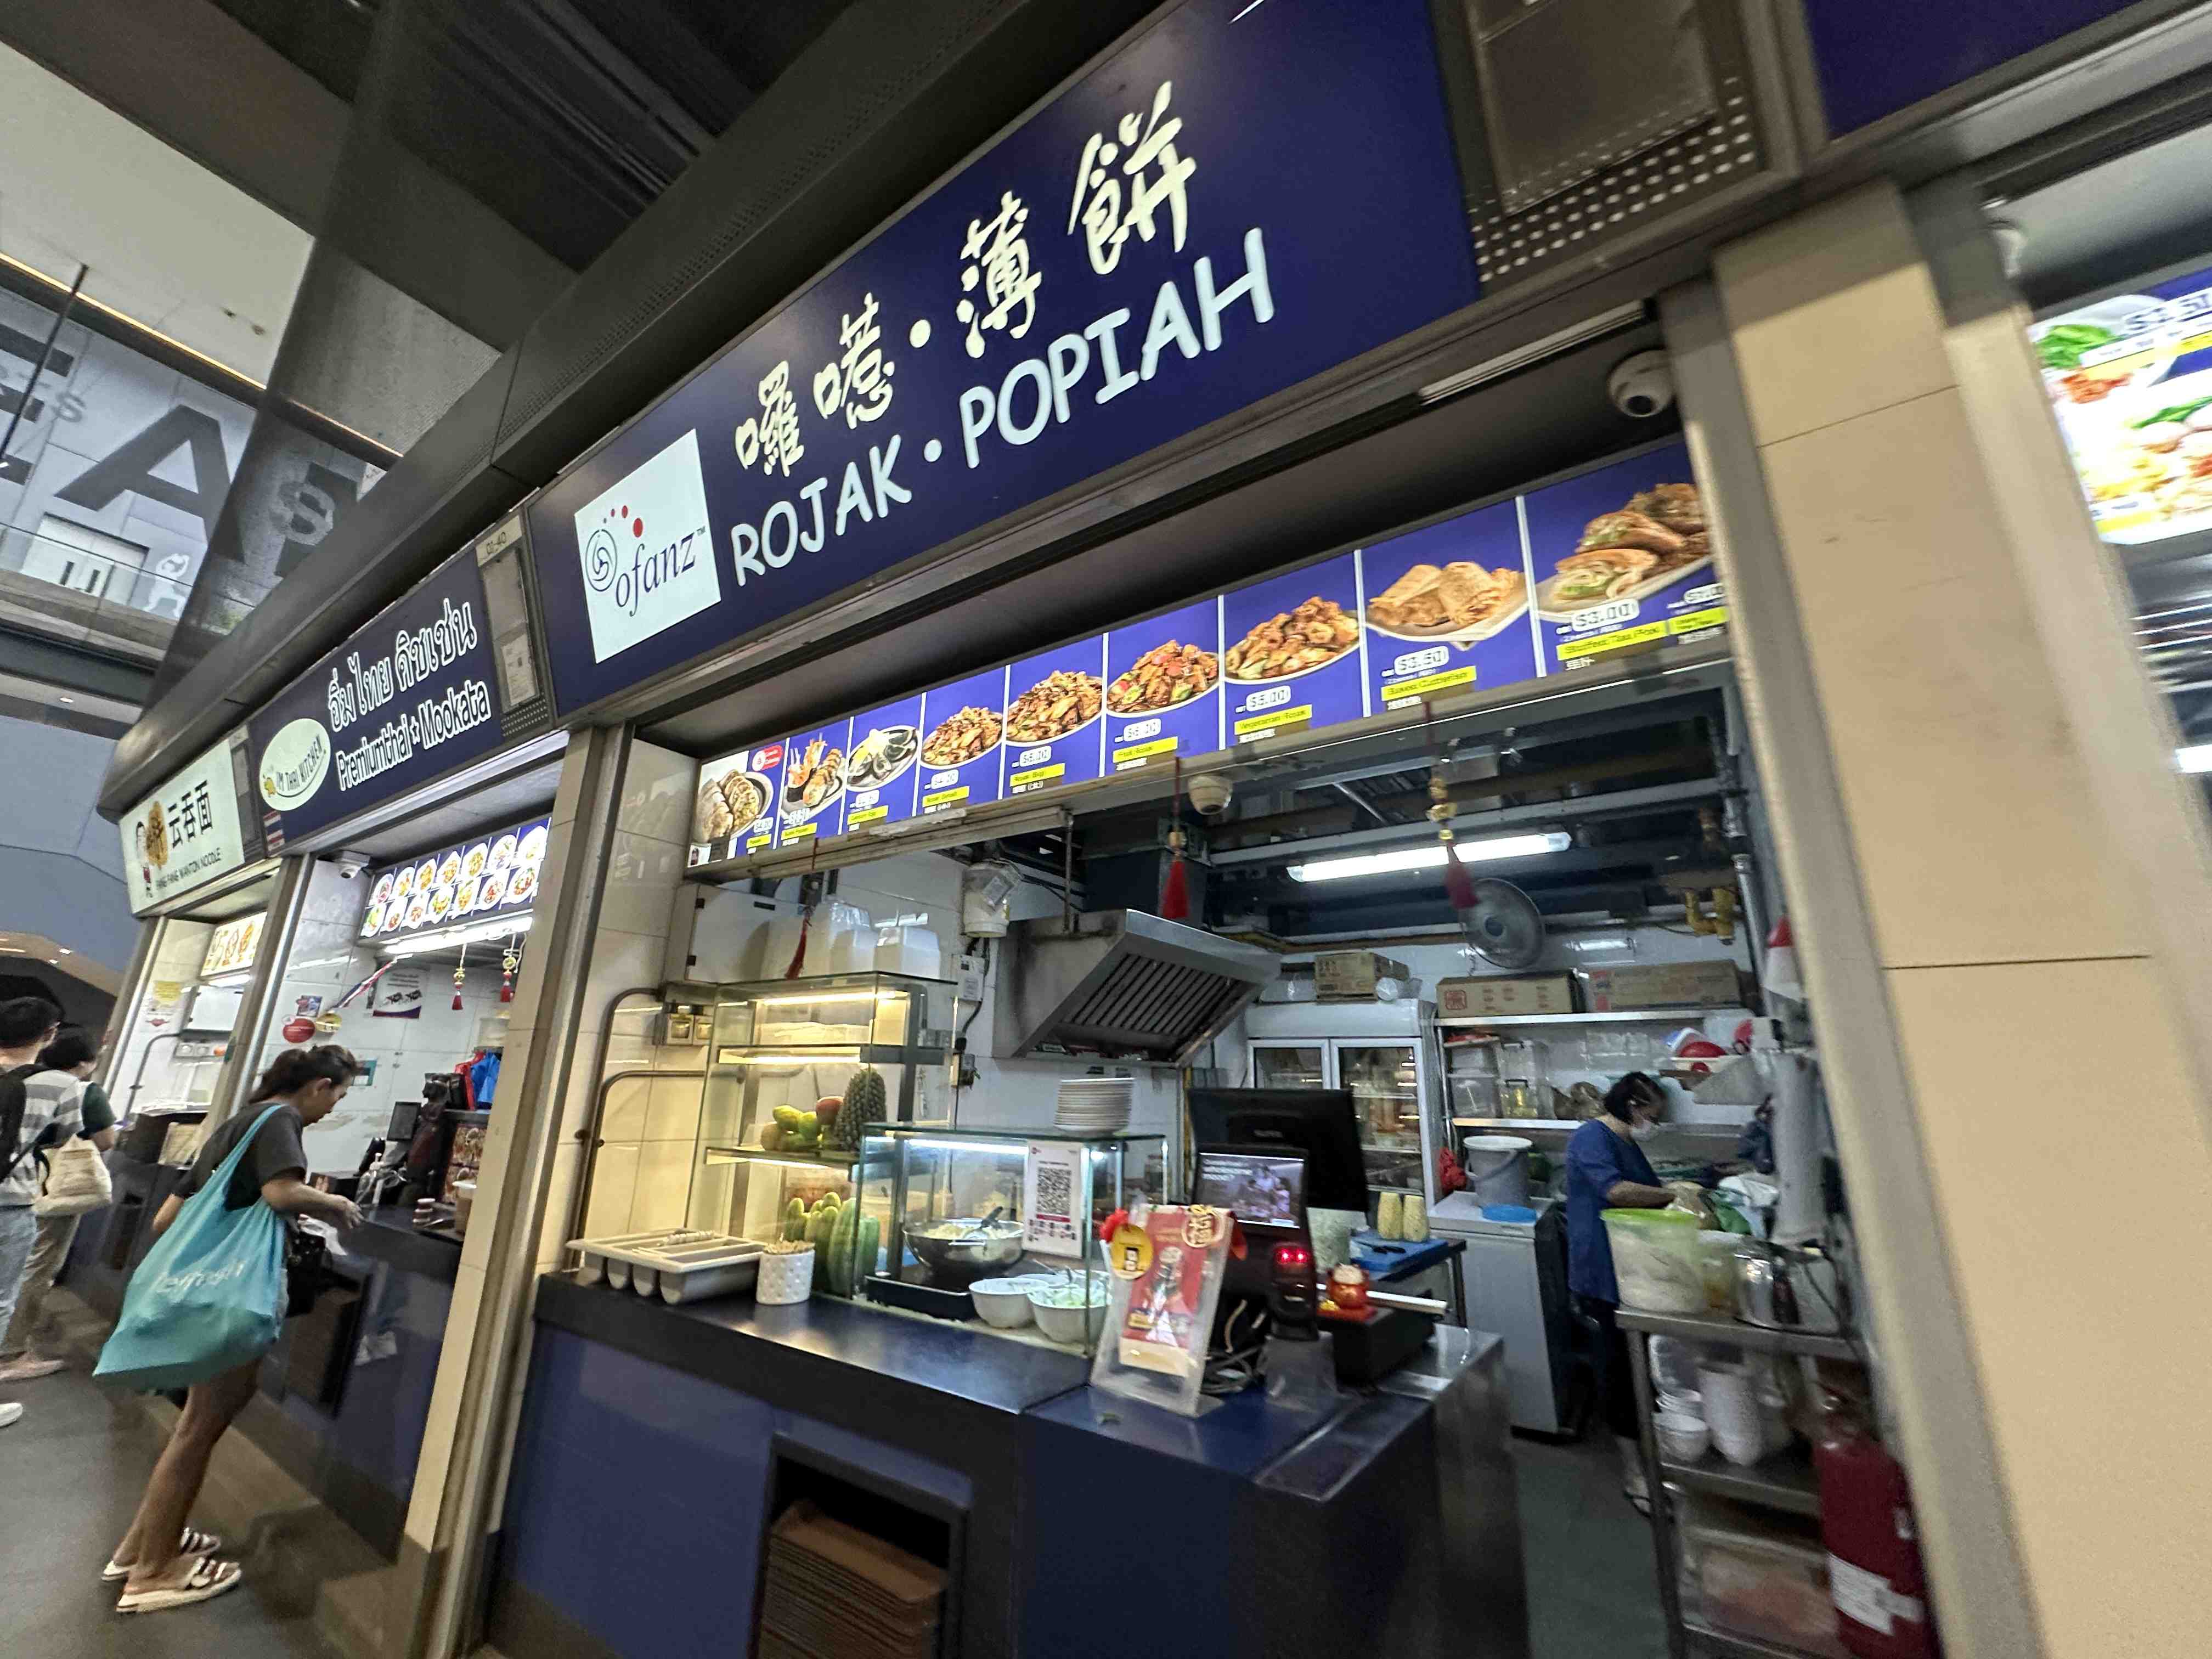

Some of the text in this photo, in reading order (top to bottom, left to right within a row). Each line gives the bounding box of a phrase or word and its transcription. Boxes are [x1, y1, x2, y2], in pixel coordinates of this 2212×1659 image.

[730, 228, 1274, 586] ROJAK POPIAH
[418, 680, 492, 750] Mookata
[167, 779, 213, 849] 云吞面
